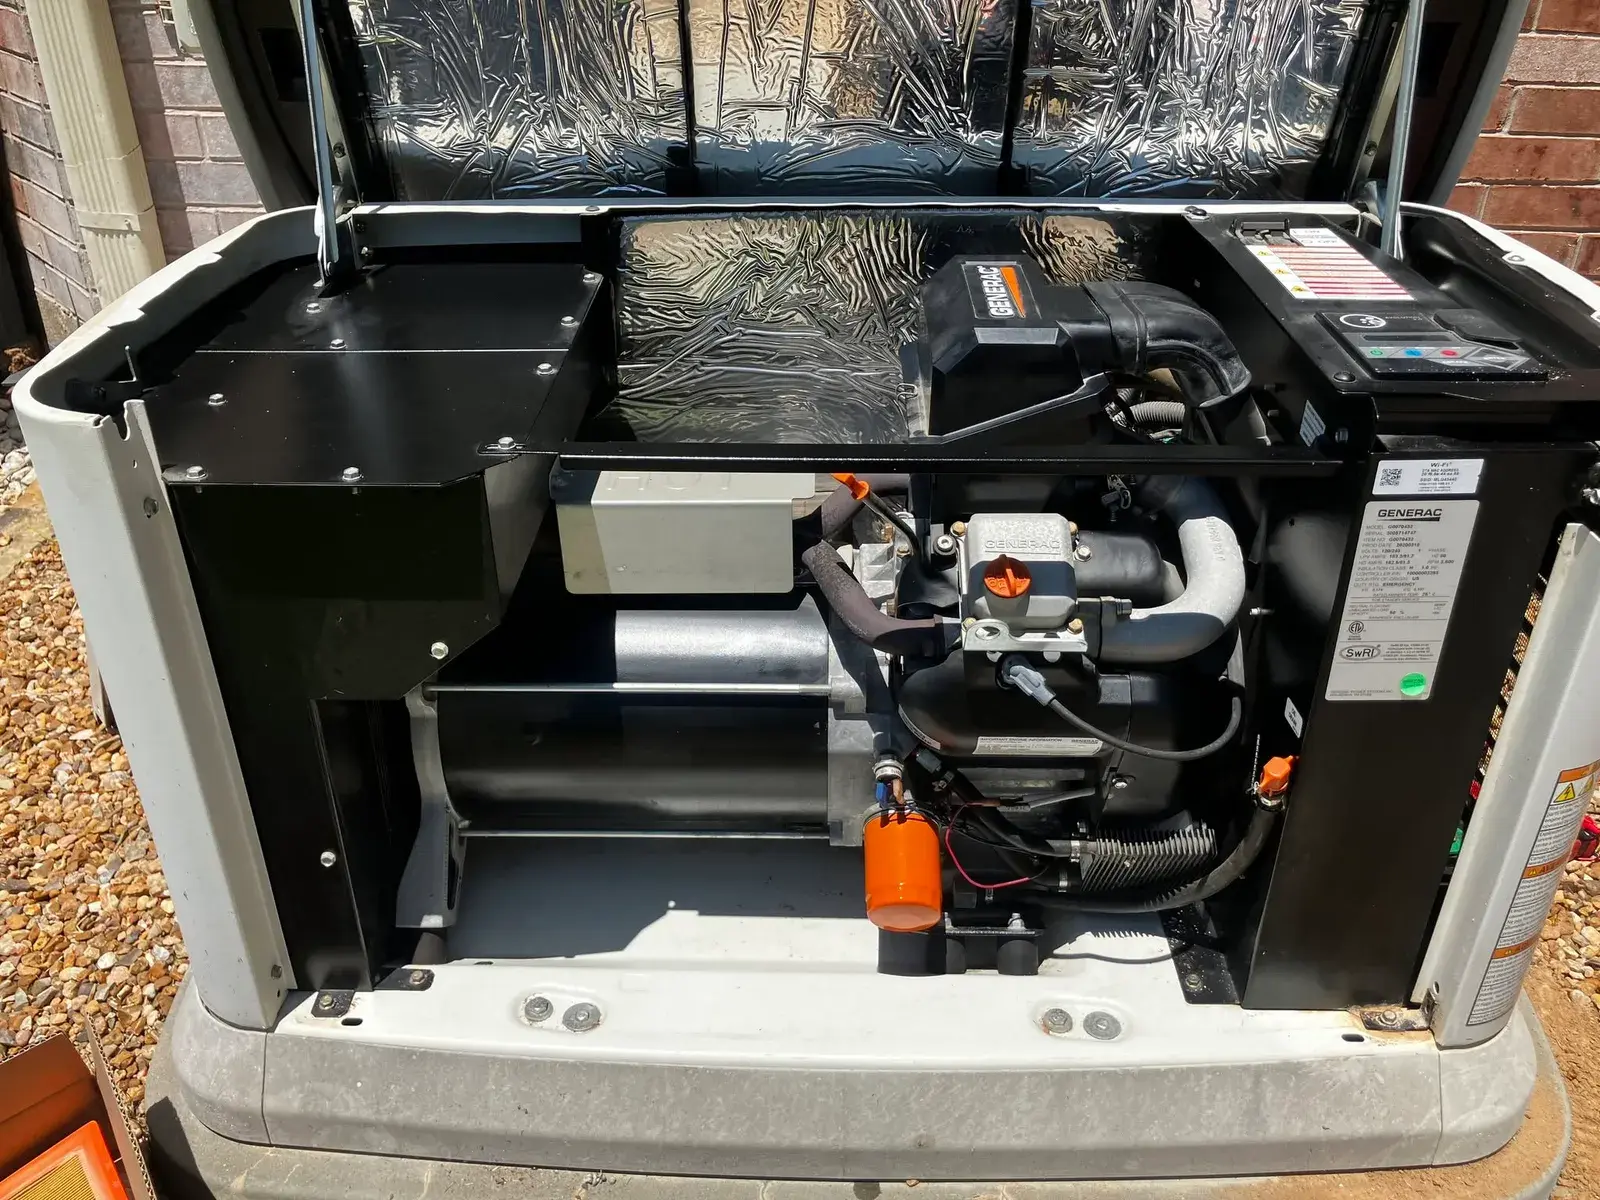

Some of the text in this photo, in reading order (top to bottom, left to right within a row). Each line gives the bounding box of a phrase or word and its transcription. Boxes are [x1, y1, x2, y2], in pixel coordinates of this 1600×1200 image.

[976, 265, 1015, 317] GENERAC
[1377, 508, 1443, 518] GENERAC
[985, 539, 1061, 549] GENERAC
[1345, 648, 1375, 658] SwRI
